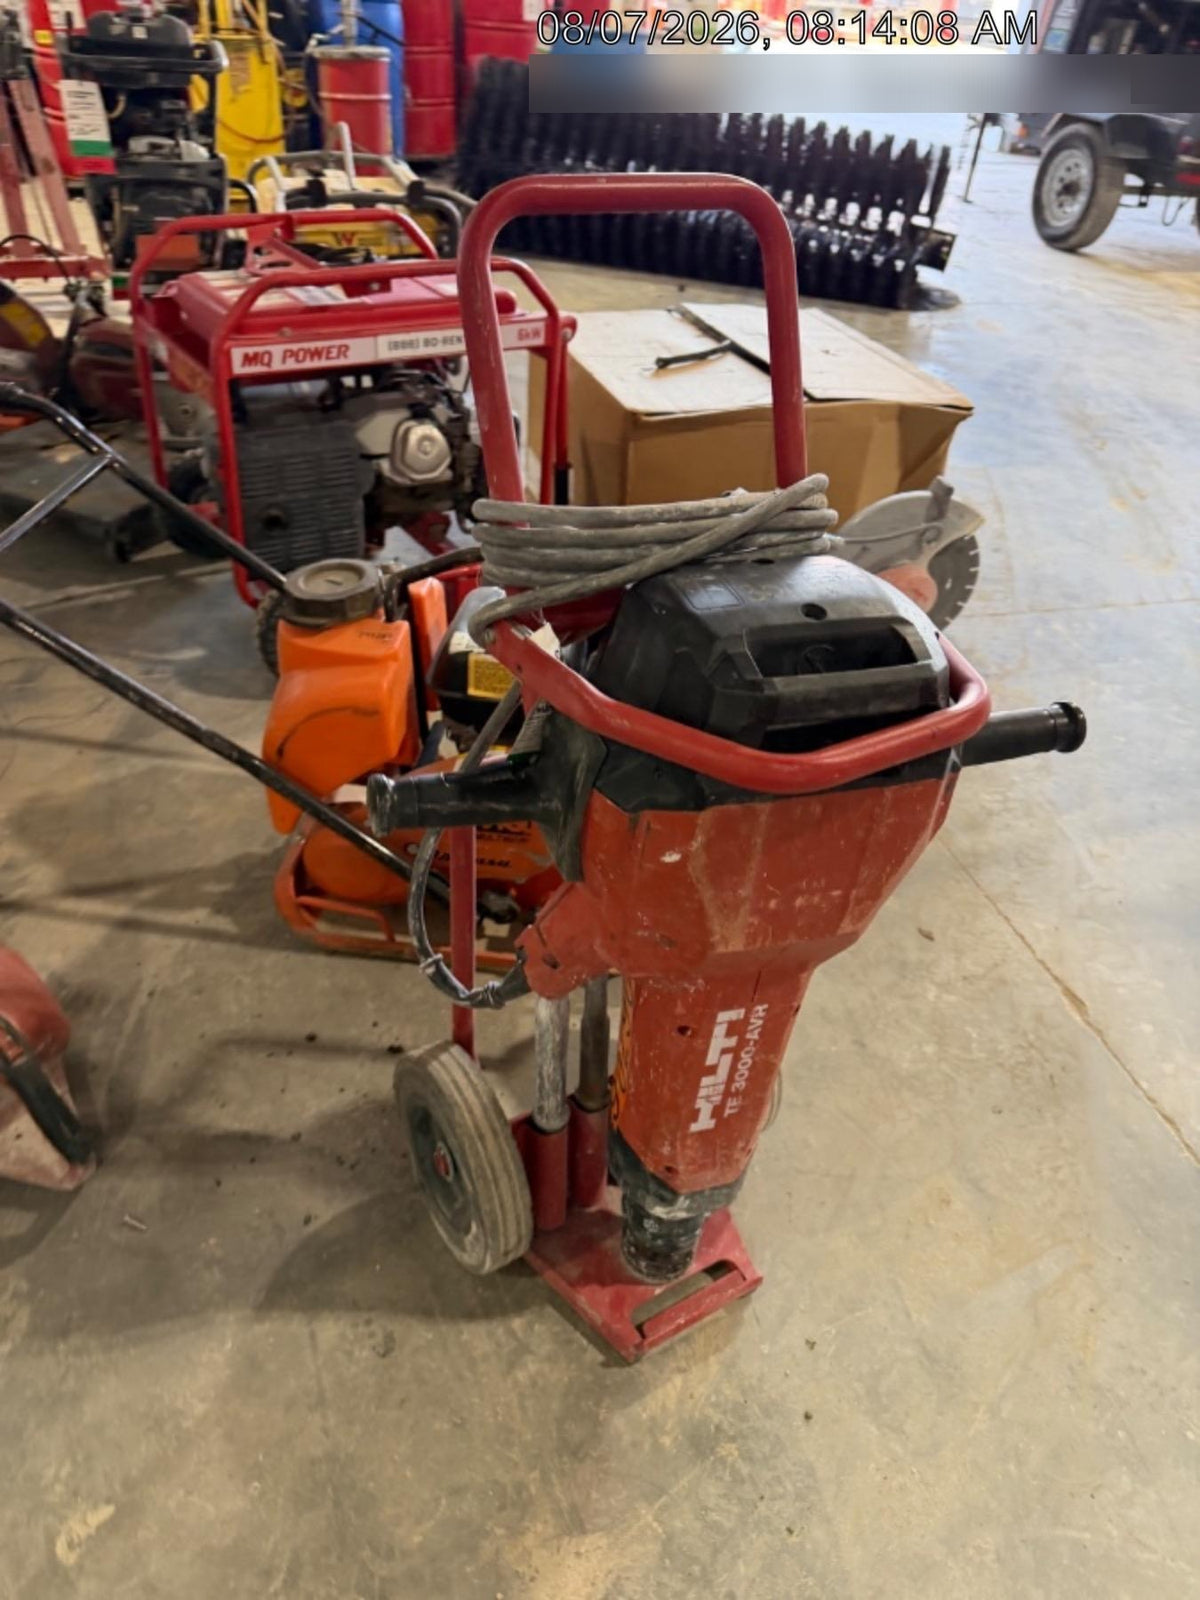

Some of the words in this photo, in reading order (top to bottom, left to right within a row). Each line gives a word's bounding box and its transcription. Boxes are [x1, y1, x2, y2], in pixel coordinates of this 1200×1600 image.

[241, 350, 273, 369] MQ
[282, 343, 350, 365] POWER
[690, 1008, 746, 1133] HILTI
[731, 1004, 769, 1093] 3000-AVR
[723, 1096, 743, 1118] TE
